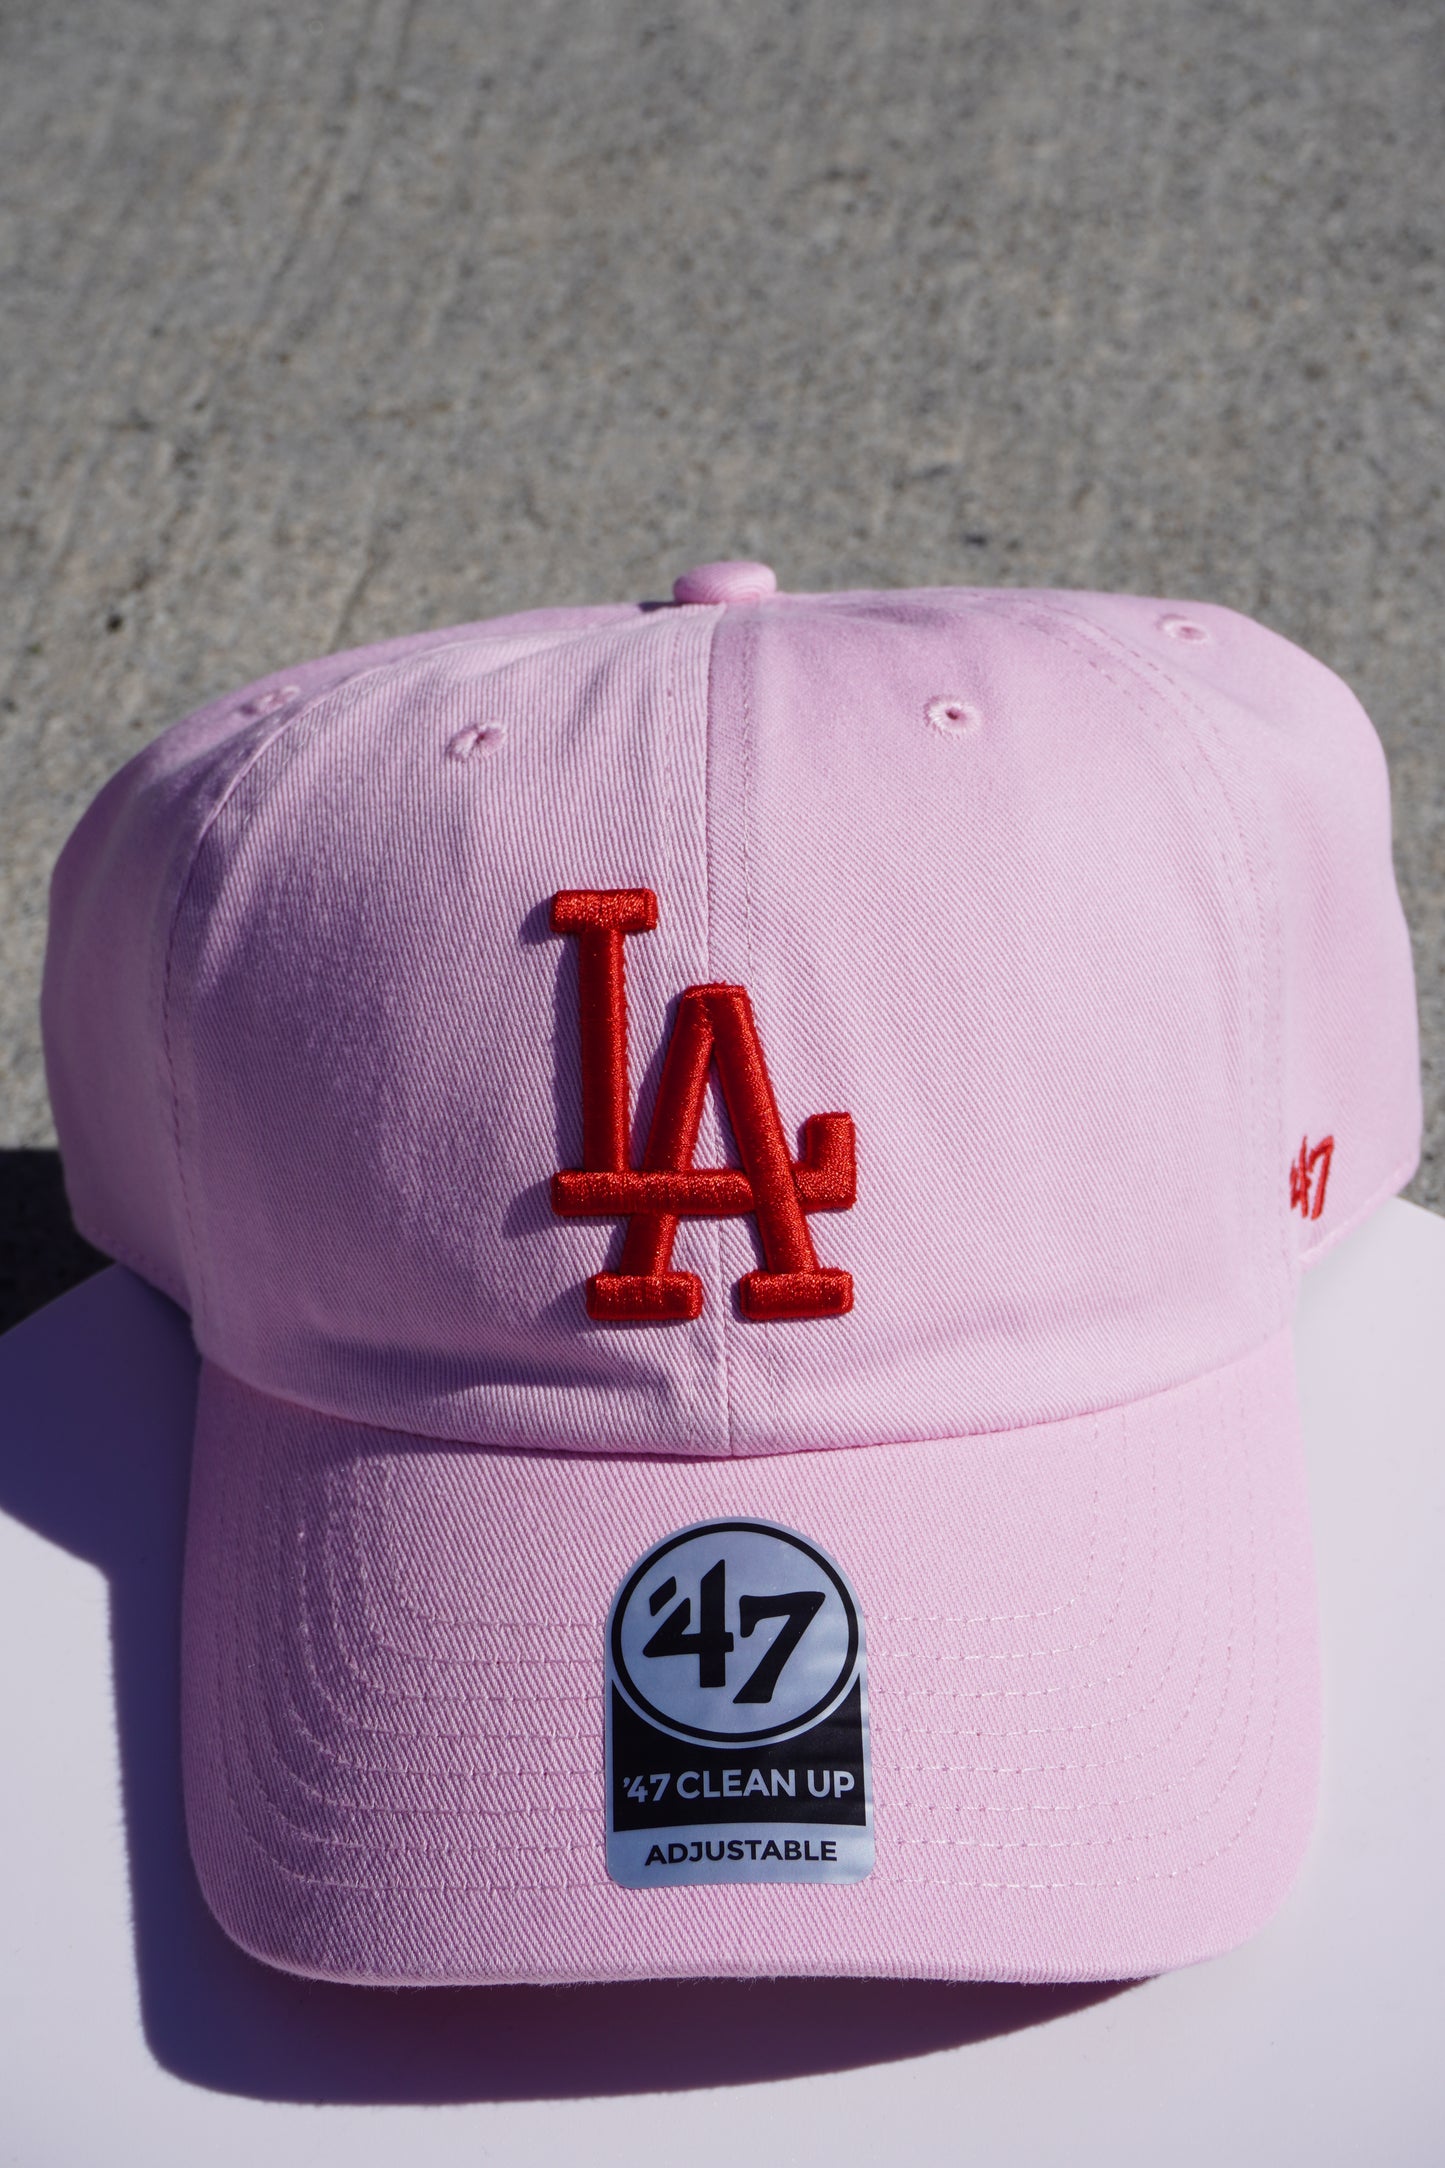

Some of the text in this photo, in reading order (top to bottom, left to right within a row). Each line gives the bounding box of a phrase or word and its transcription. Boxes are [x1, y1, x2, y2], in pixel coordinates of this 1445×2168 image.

[550, 888, 857, 1321] LA
[676, 1768, 796, 1799] CLEAN
[806, 1769, 856, 1798] UP
[644, 1839, 838, 1866] ADJUSTABLE
